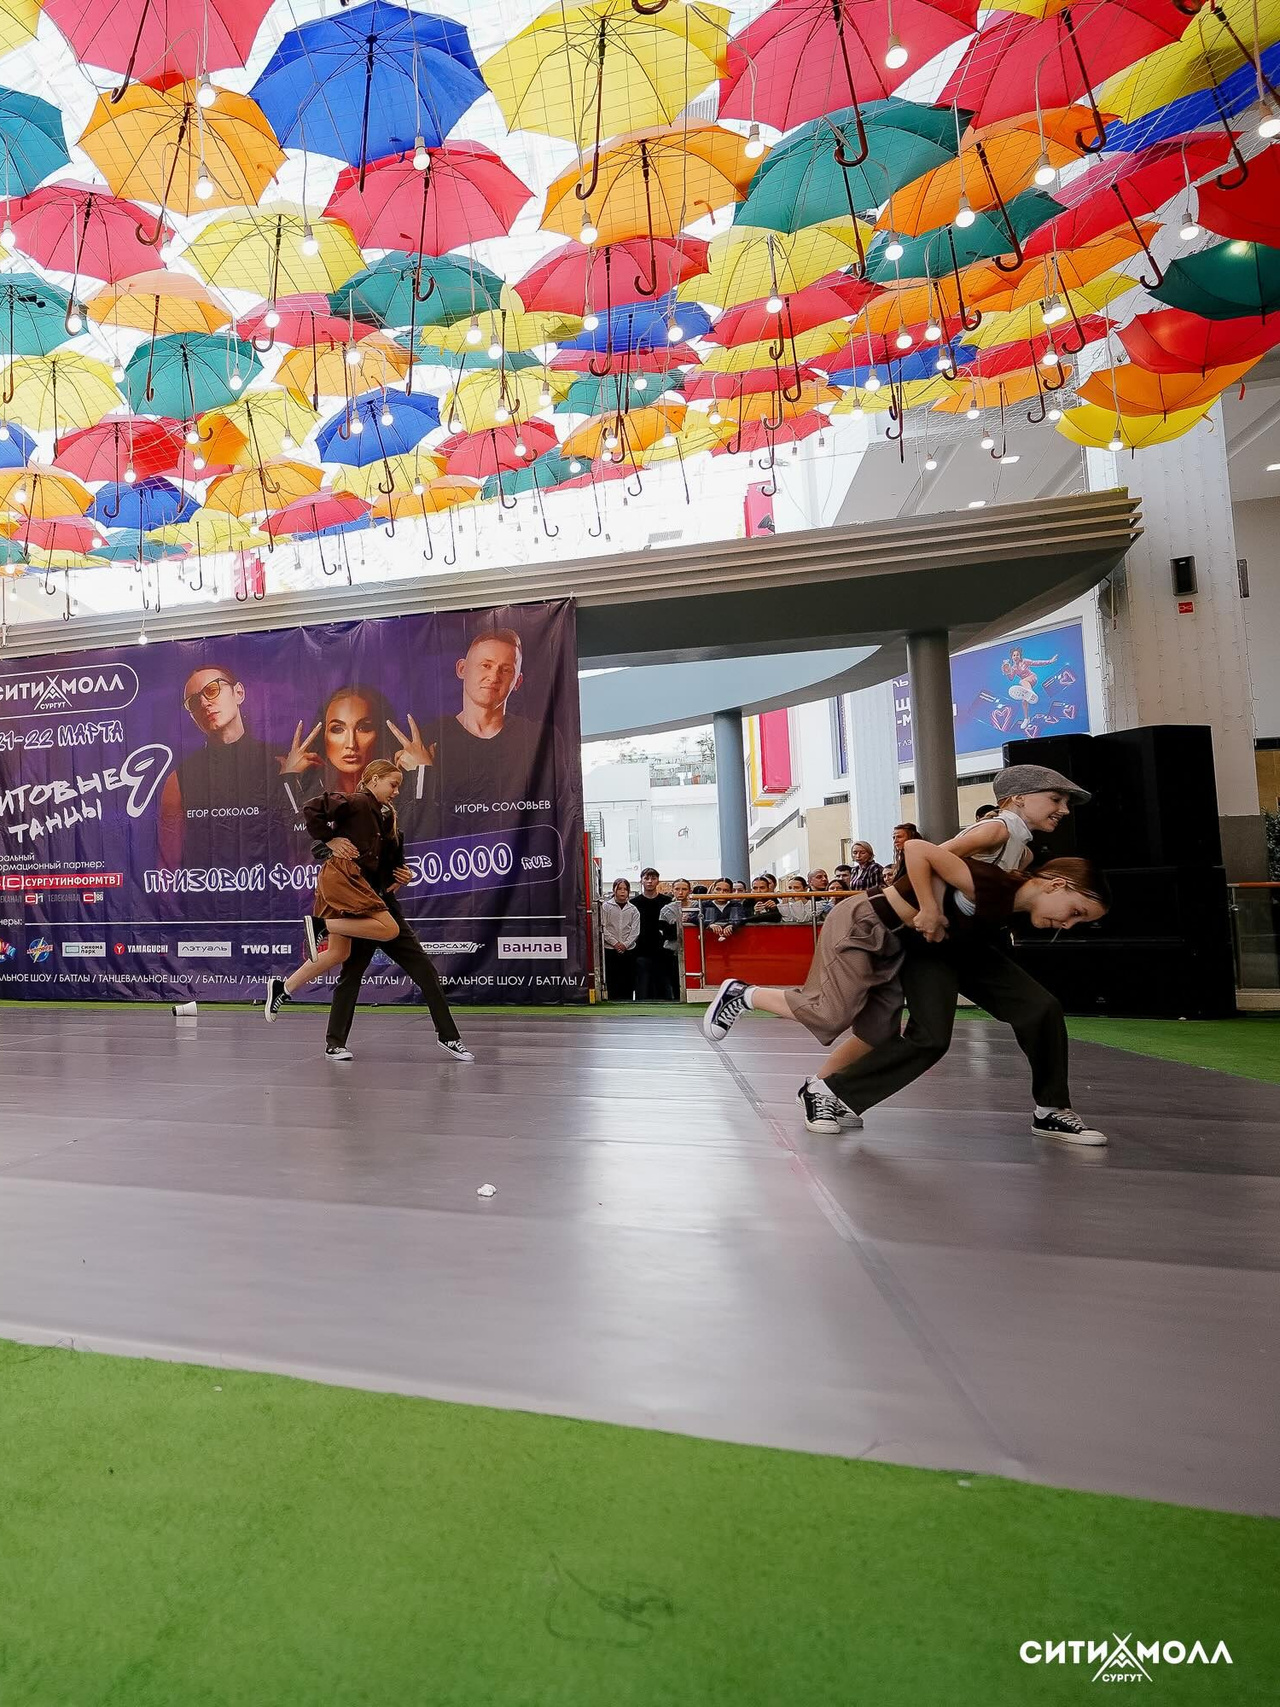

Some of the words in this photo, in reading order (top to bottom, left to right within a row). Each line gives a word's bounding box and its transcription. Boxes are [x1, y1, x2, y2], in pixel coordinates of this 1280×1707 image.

[61, 673, 125, 695] МОЛЛ
[40, 701, 66, 710] СУРГУТ
[57, 719, 124, 746] МАРТА
[186, 809, 209, 818] ЕГОР
[211, 806, 259, 817] СОКОЛОВ
[455, 803, 489, 813] ИГОРЬ
[492, 800, 551, 812] СОЛОВЬЕВ
[8, 799, 102, 843] ТАНЦЫ
[63, 860, 105, 870] партнер:
[144, 863, 266, 893] ПРИЗОВОЙ
[269, 863, 323, 890] ФОН
[521, 854, 552, 870] RUB
[127, 944, 168, 954] YAMAGUCHI
[241, 944, 269, 954] TWO
[272, 944, 292, 954] KEI
[502, 942, 563, 953] ванлав
[30, 973, 52, 982] ШОУ
[59, 974, 90, 983] БАТТЛЫ
[99, 974, 168, 984] ТАНЦЕВАЛЬНОЕ
[170, 974, 193, 984] ШОУ
[202, 974, 237, 984] БАТТЛЫ
[361, 975, 399, 985] БАТТЛЫ
[497, 975, 526, 986] ШОУ
[536, 975, 577, 986] БАТТЛЫ
